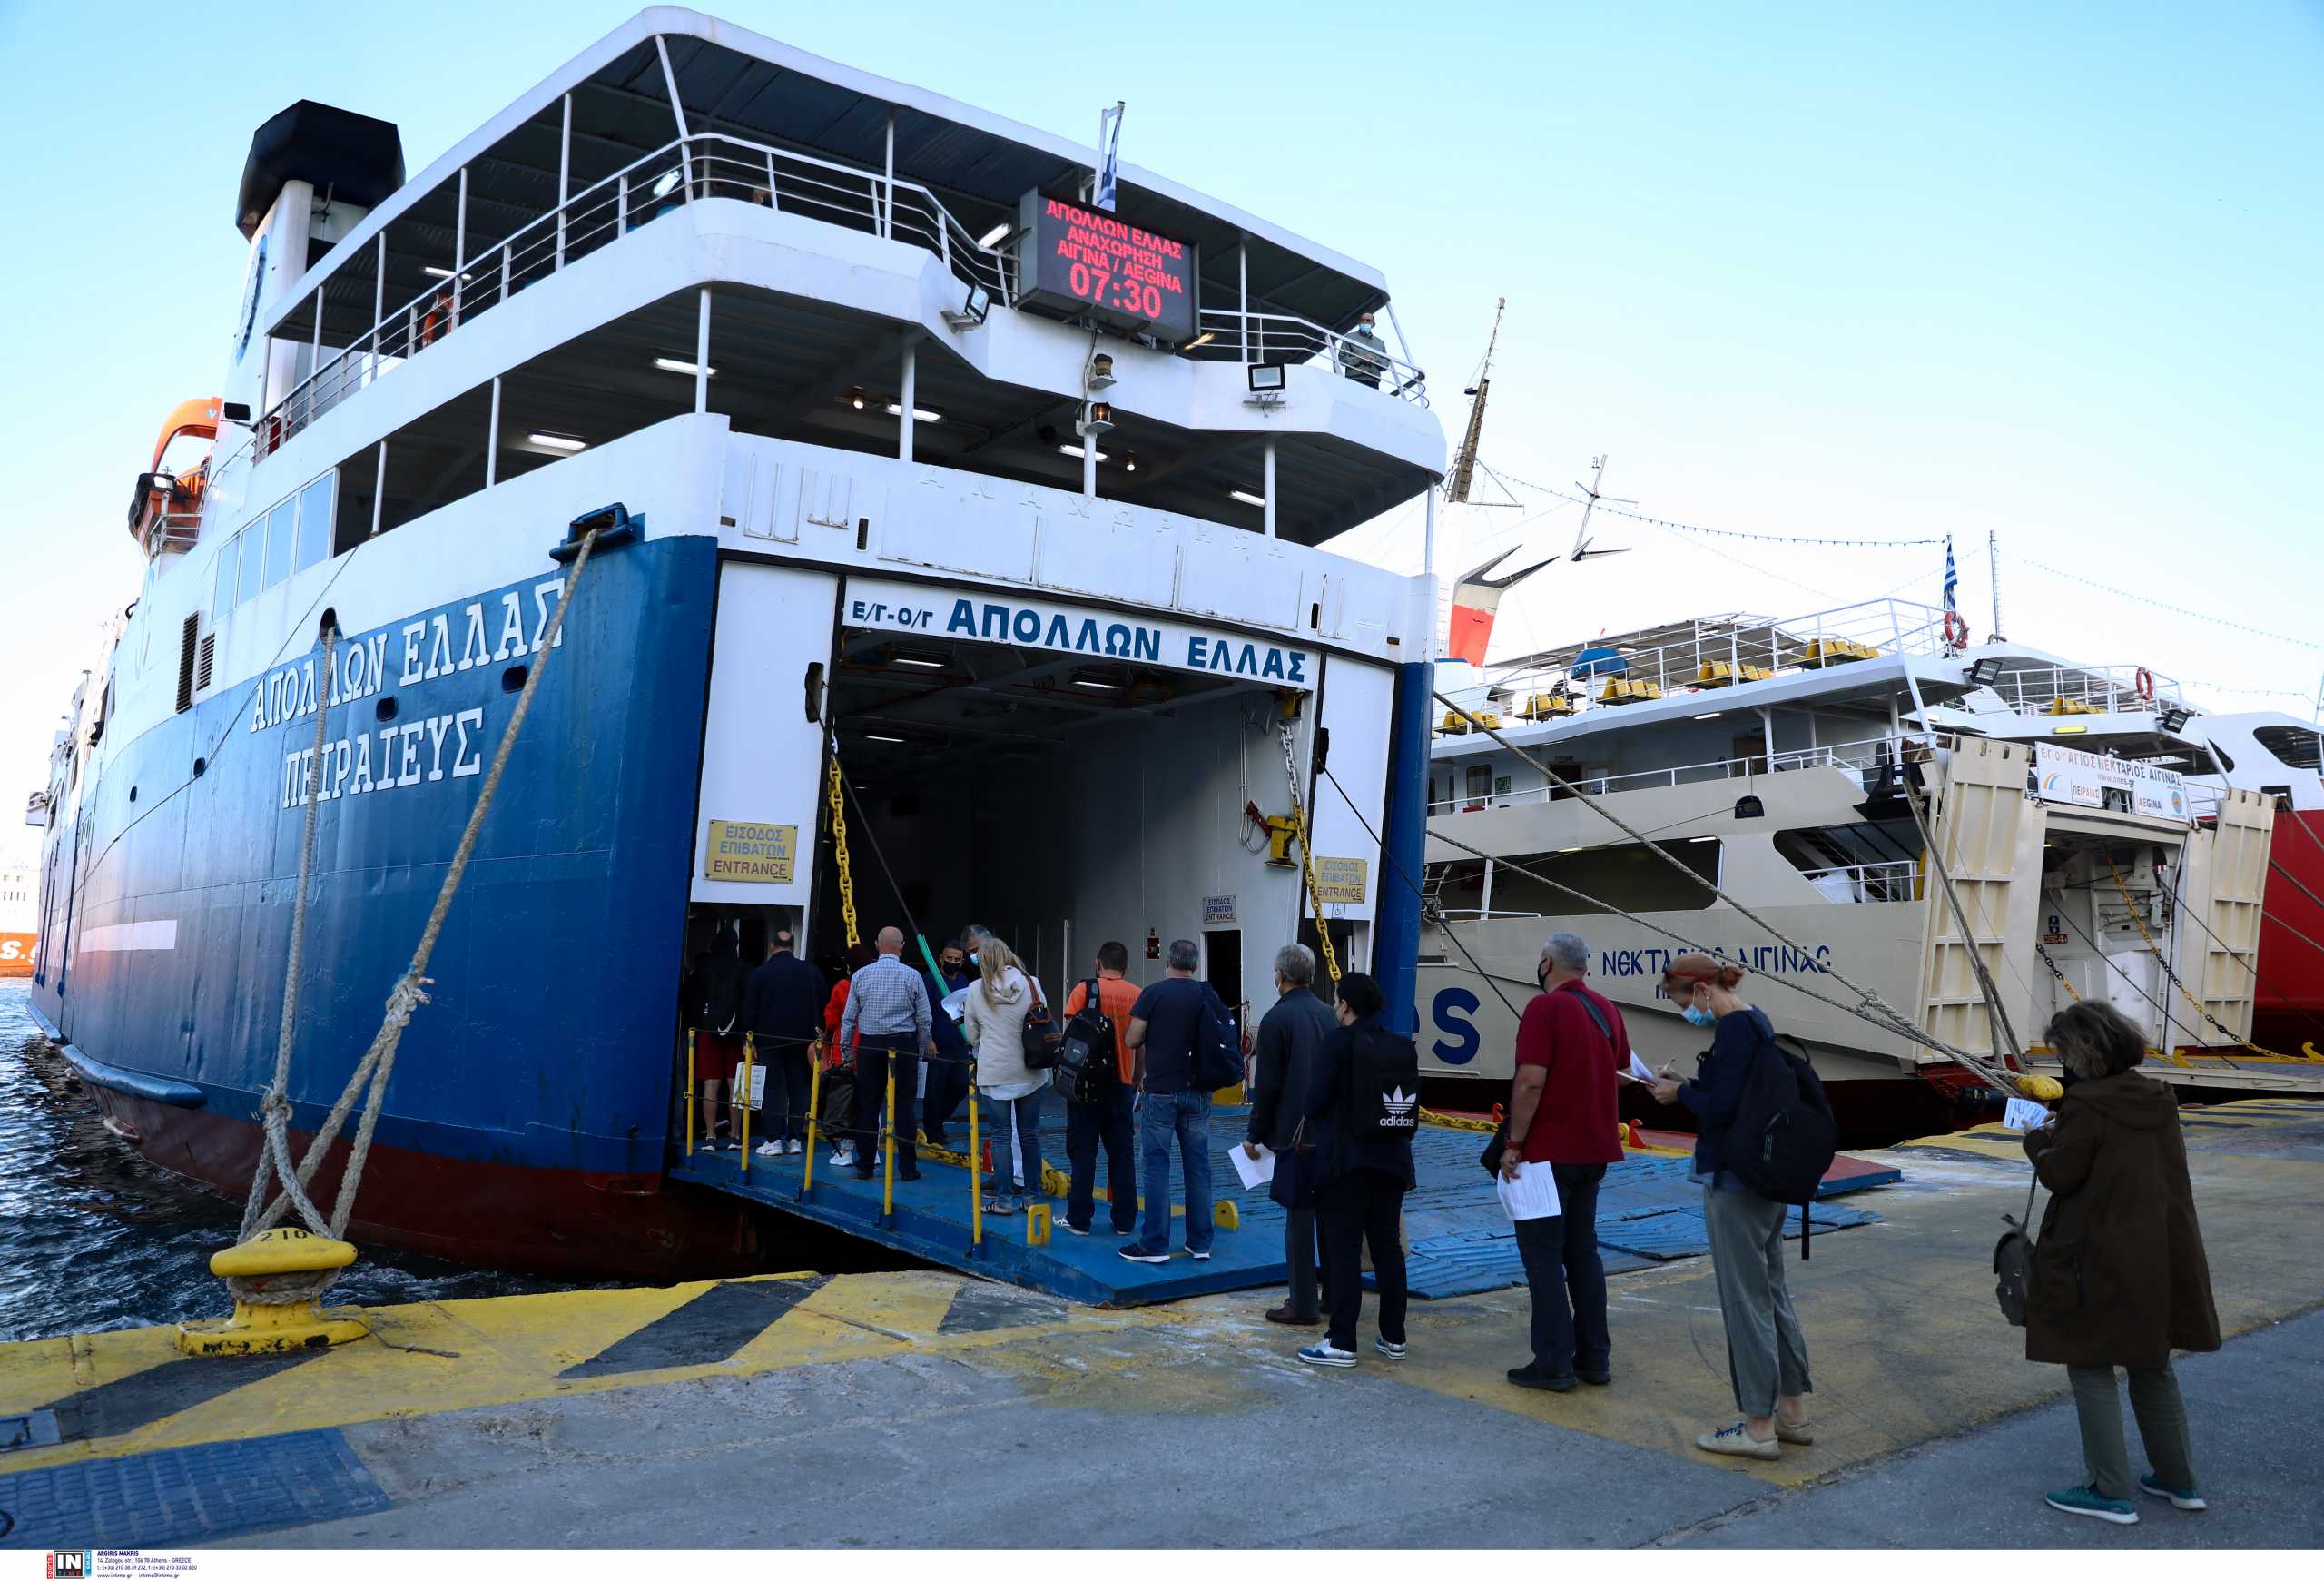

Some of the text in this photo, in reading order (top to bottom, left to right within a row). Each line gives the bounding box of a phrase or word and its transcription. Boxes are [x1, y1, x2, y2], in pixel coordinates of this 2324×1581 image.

[1046, 199, 1182, 260] ΑΠΟΛΛΩΝ ΕΛΛΑΣ
[1057, 240, 1109, 272] ΑΙΓΙΝΑ
[1068, 228, 1162, 271] ΑΝΑΧΩΡΗΣΗ
[1069, 262, 1162, 319] 07:30
[399, 578, 566, 687] ΕΛΛΑΣ
[852, 598, 1306, 683] Ε/Γ-Ο/Γ ΑΠΟΛΛΩΝ ΕΛΛΑΣ
[2149, 767, 2181, 786] ΑΙΓΙΝΑΣ
[2139, 795, 2162, 810] AEGINA
[725, 825, 783, 842] ΕΙΣΟΔΟΣ
[720, 841, 786, 856] ΕΠΙΒΑΤΩΝ
[714, 859, 787, 875] ENTRANCE
[1317, 886, 1361, 898] ENTRANCE
[1206, 912, 1235, 921] ENTRANCE
[1380, 1115, 1414, 1127] adidas
[260, 1230, 309, 1242] 210
